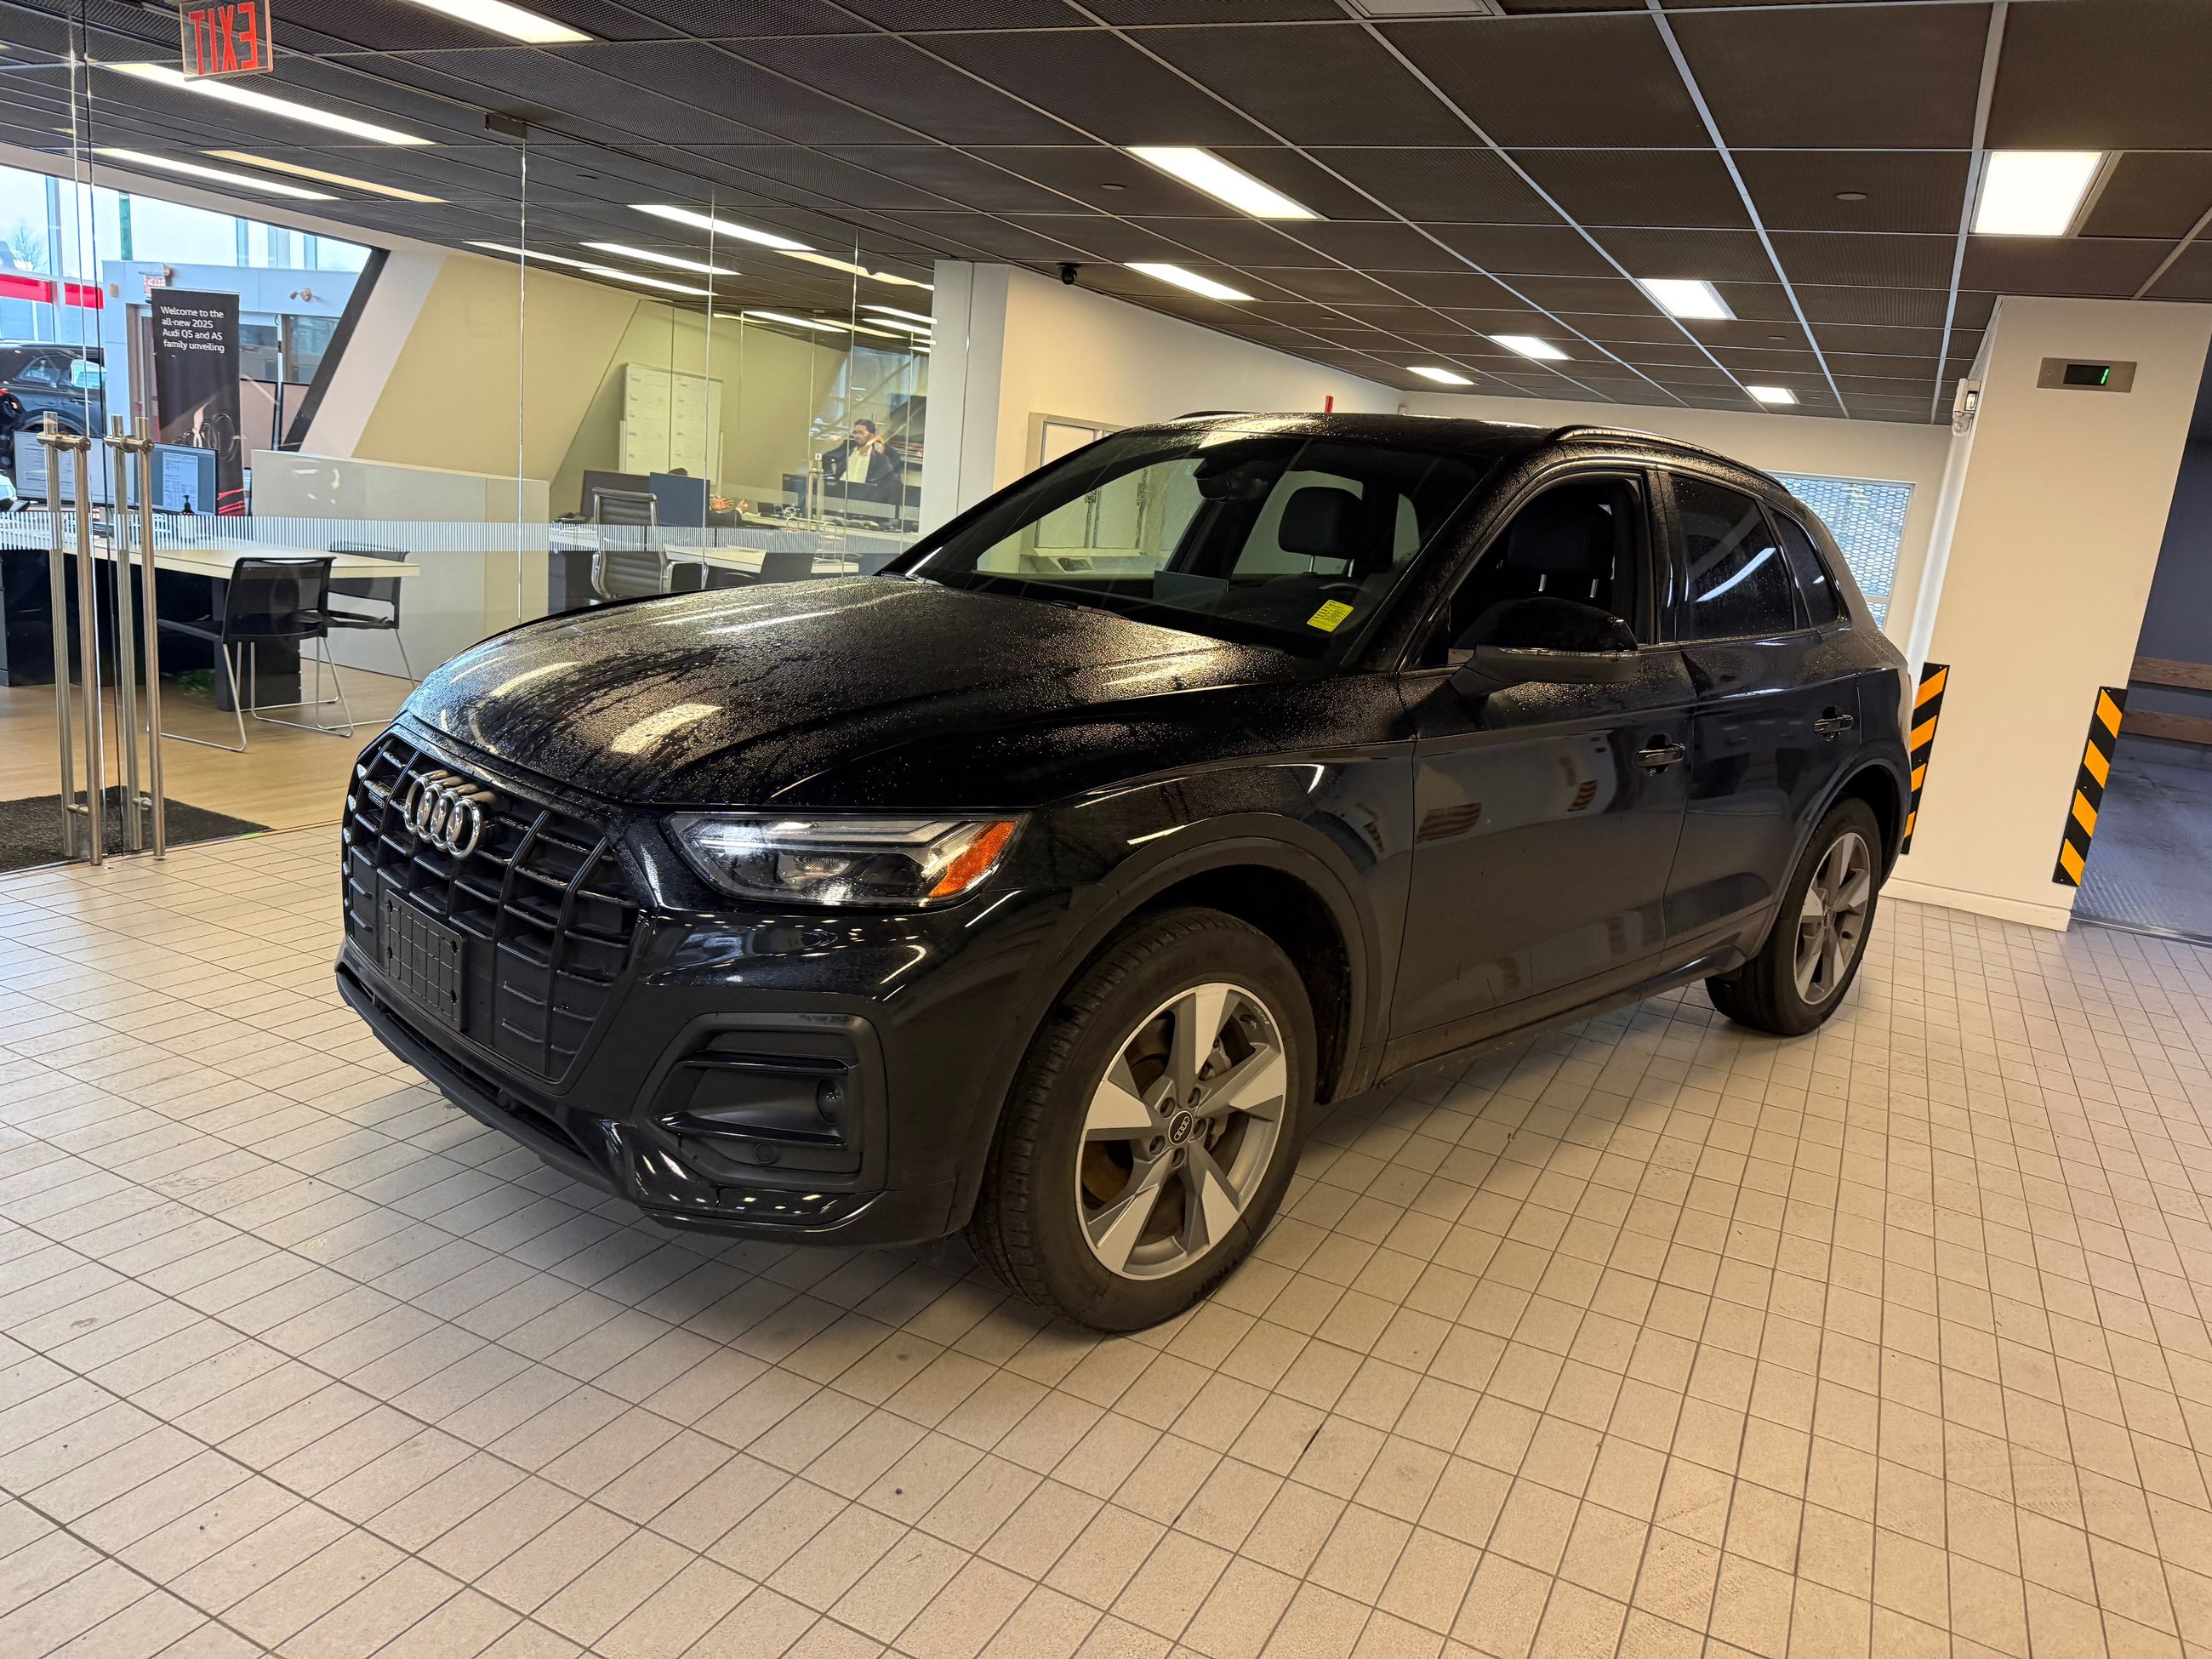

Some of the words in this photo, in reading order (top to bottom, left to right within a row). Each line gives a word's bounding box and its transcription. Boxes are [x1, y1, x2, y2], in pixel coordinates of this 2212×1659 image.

[160, 306, 198, 316] Welcome
[199, 309, 208, 317] to
[210, 310, 225, 318] the
[162, 317, 191, 327] all-new
[192, 319, 214, 328] 2025
[162, 328, 180, 337] Audi
[181, 330, 193, 339] Q5
[163, 339, 187, 351] family
[189, 342, 225, 354] unveiling
